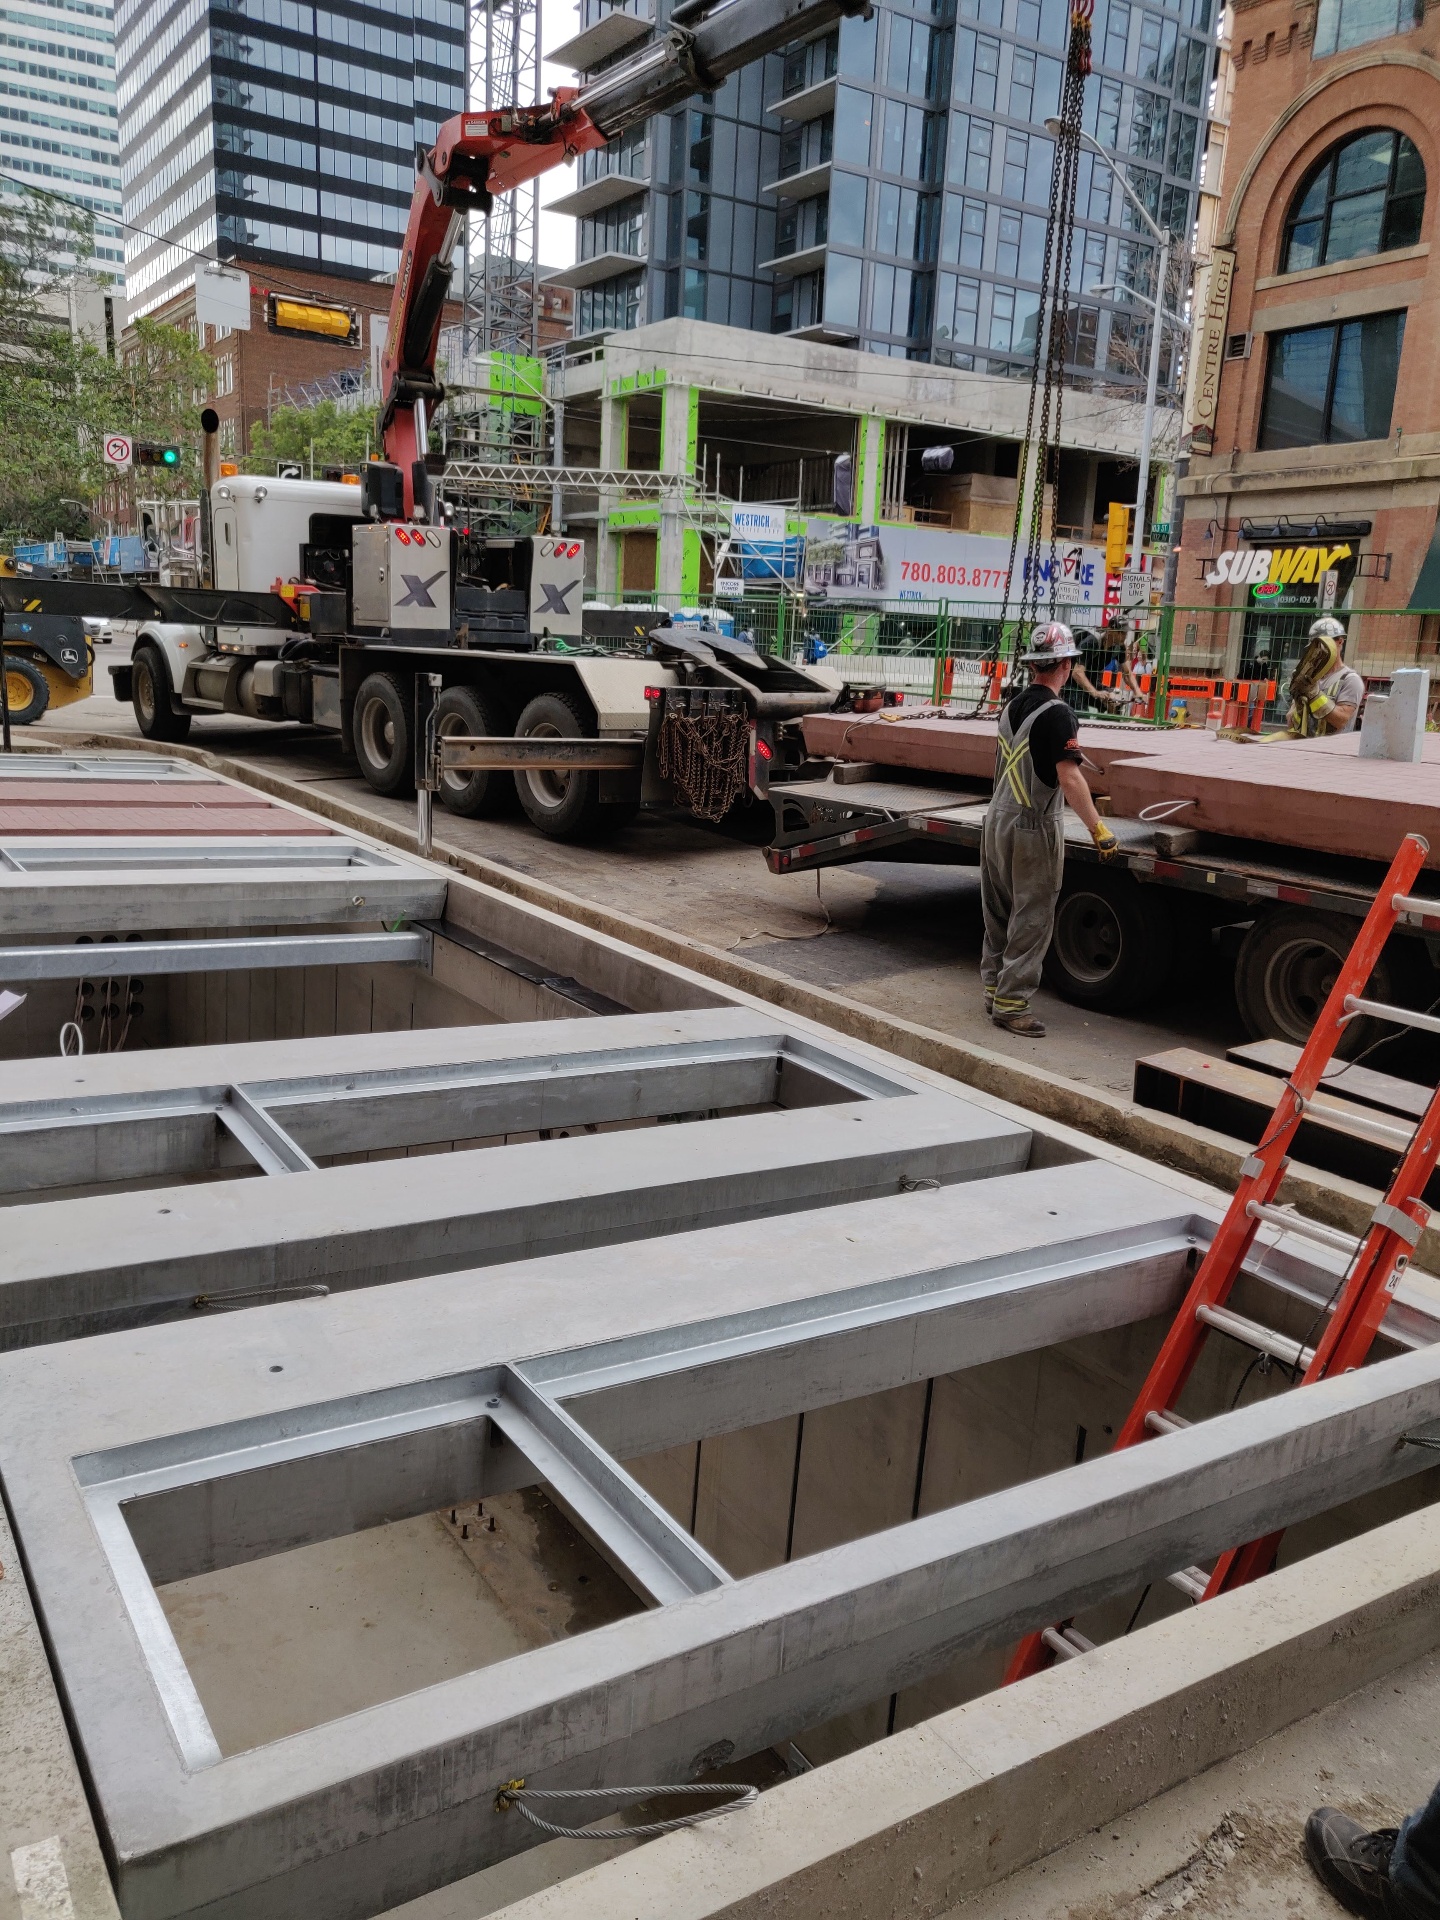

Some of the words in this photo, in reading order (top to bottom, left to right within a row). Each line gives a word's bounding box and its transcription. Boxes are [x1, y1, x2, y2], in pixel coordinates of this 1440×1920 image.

[1208, 260, 1231, 322] HIGH
[1197, 328, 1221, 419] CENTRE
[734, 513, 770, 528] WESTRICH
[900, 561, 1012, 590] 780.803.8777
[1206, 543, 1352, 584] SUBWAY
[1123, 575, 1150, 583] SIGNALS
[1128, 582, 1146, 590] STOP
